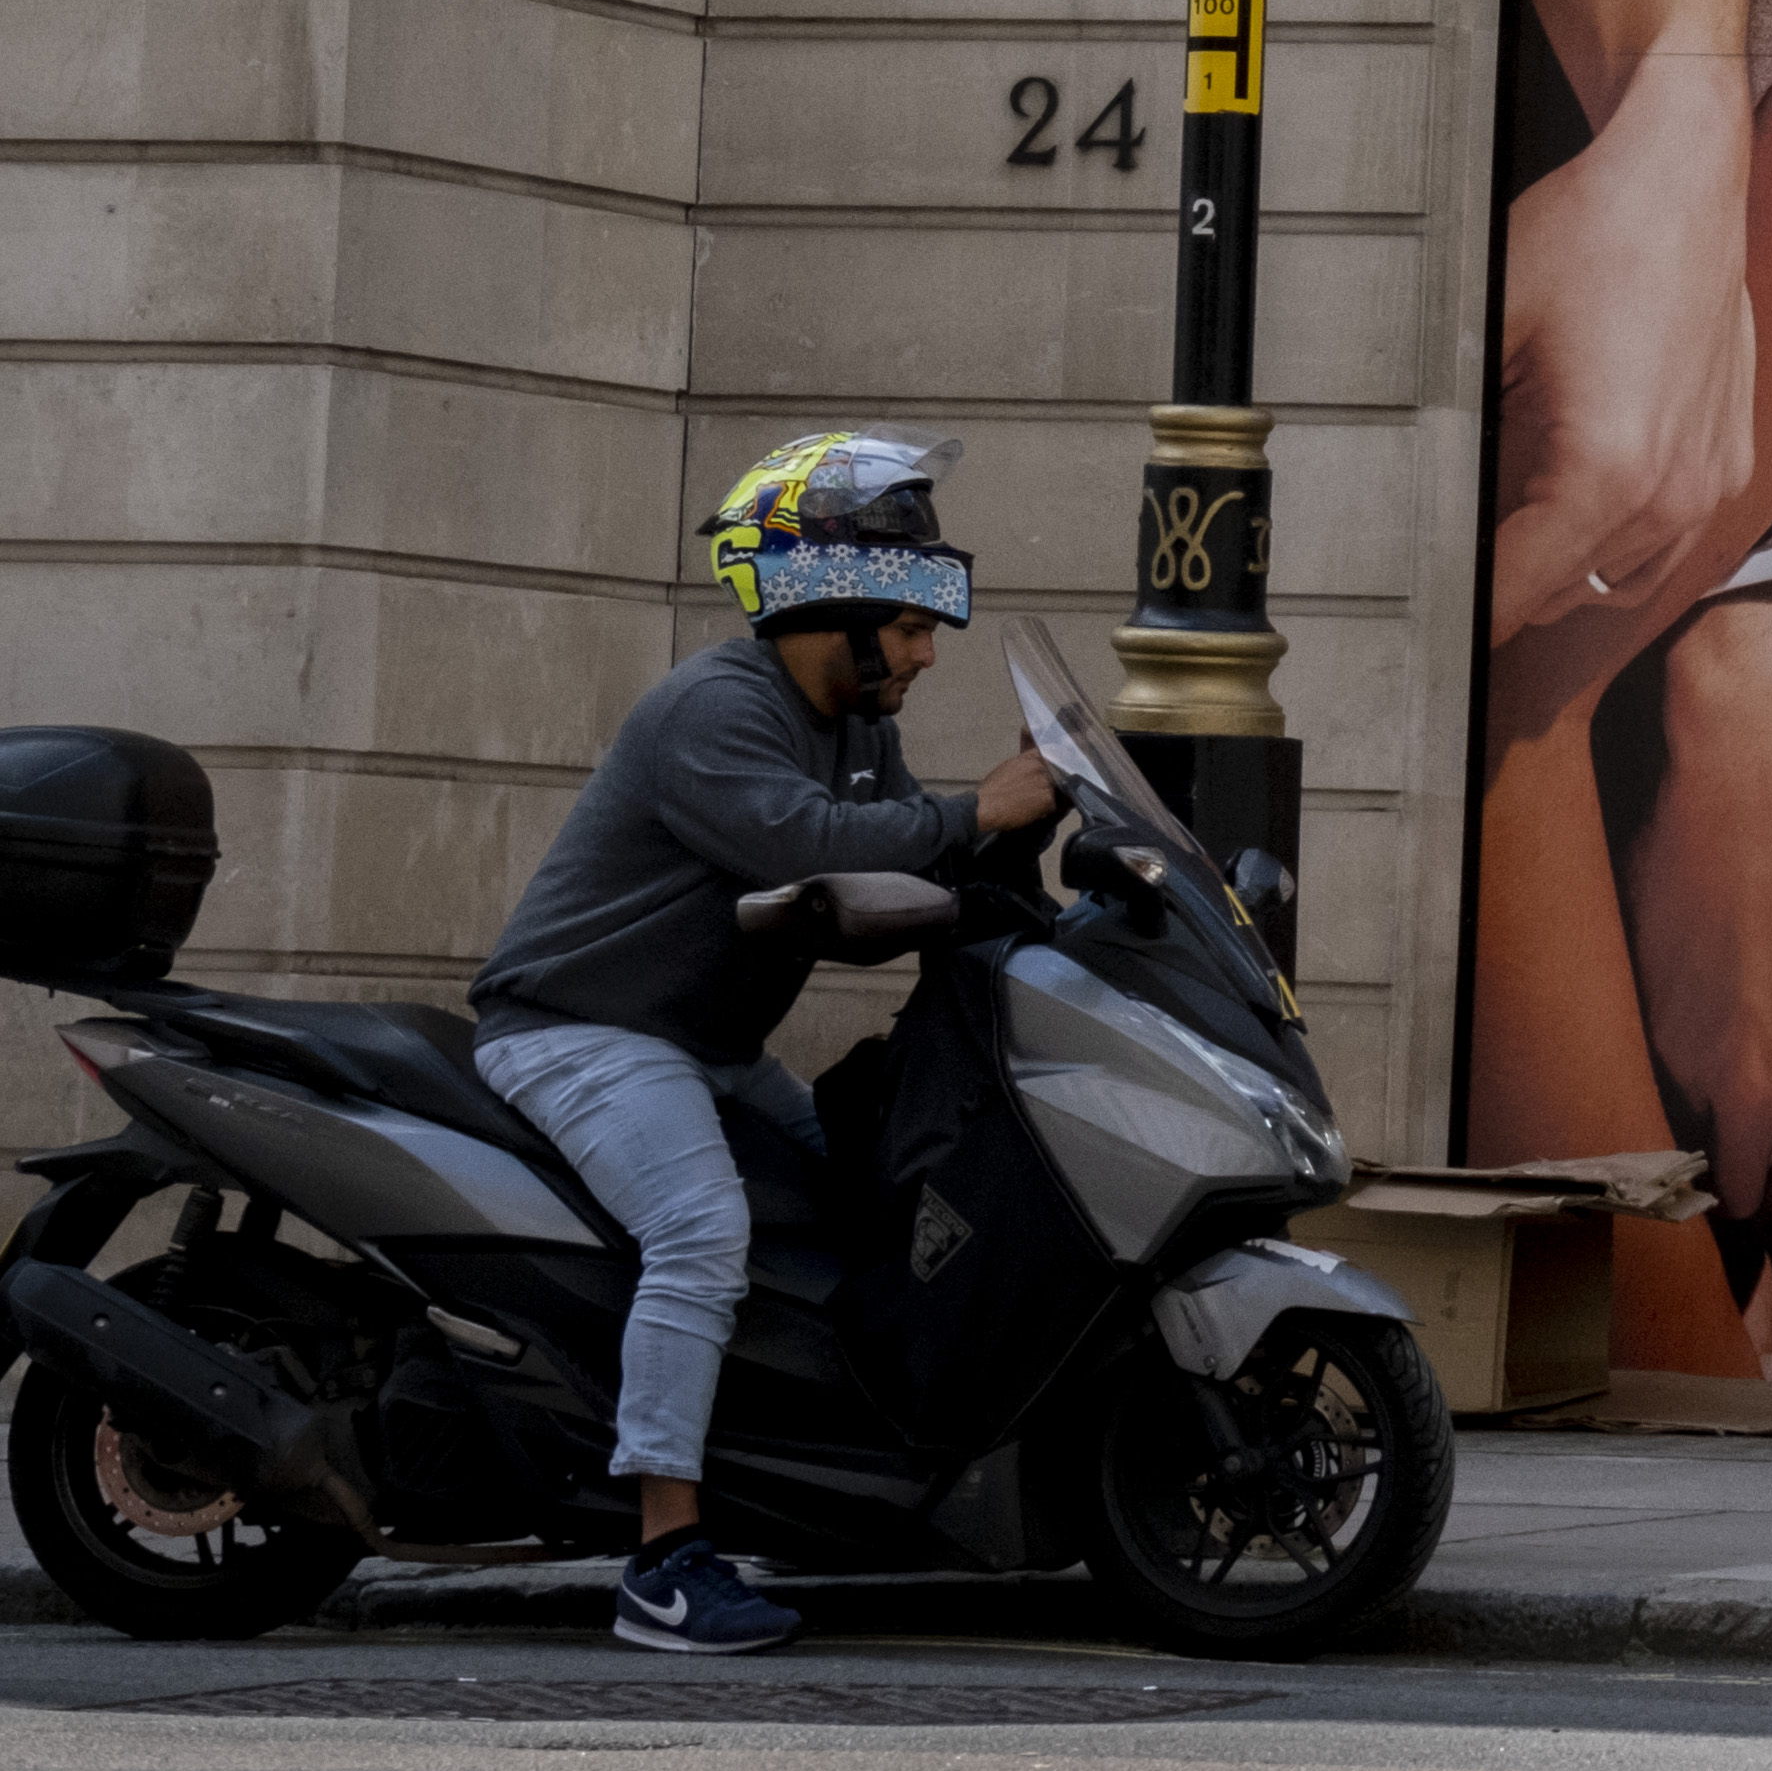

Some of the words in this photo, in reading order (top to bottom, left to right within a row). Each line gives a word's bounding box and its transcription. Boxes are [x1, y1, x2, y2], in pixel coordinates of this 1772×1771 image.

[1203, 71, 1213, 91] 1
[1006, 76, 1147, 171] 24
[1191, 198, 1216, 236] 2
